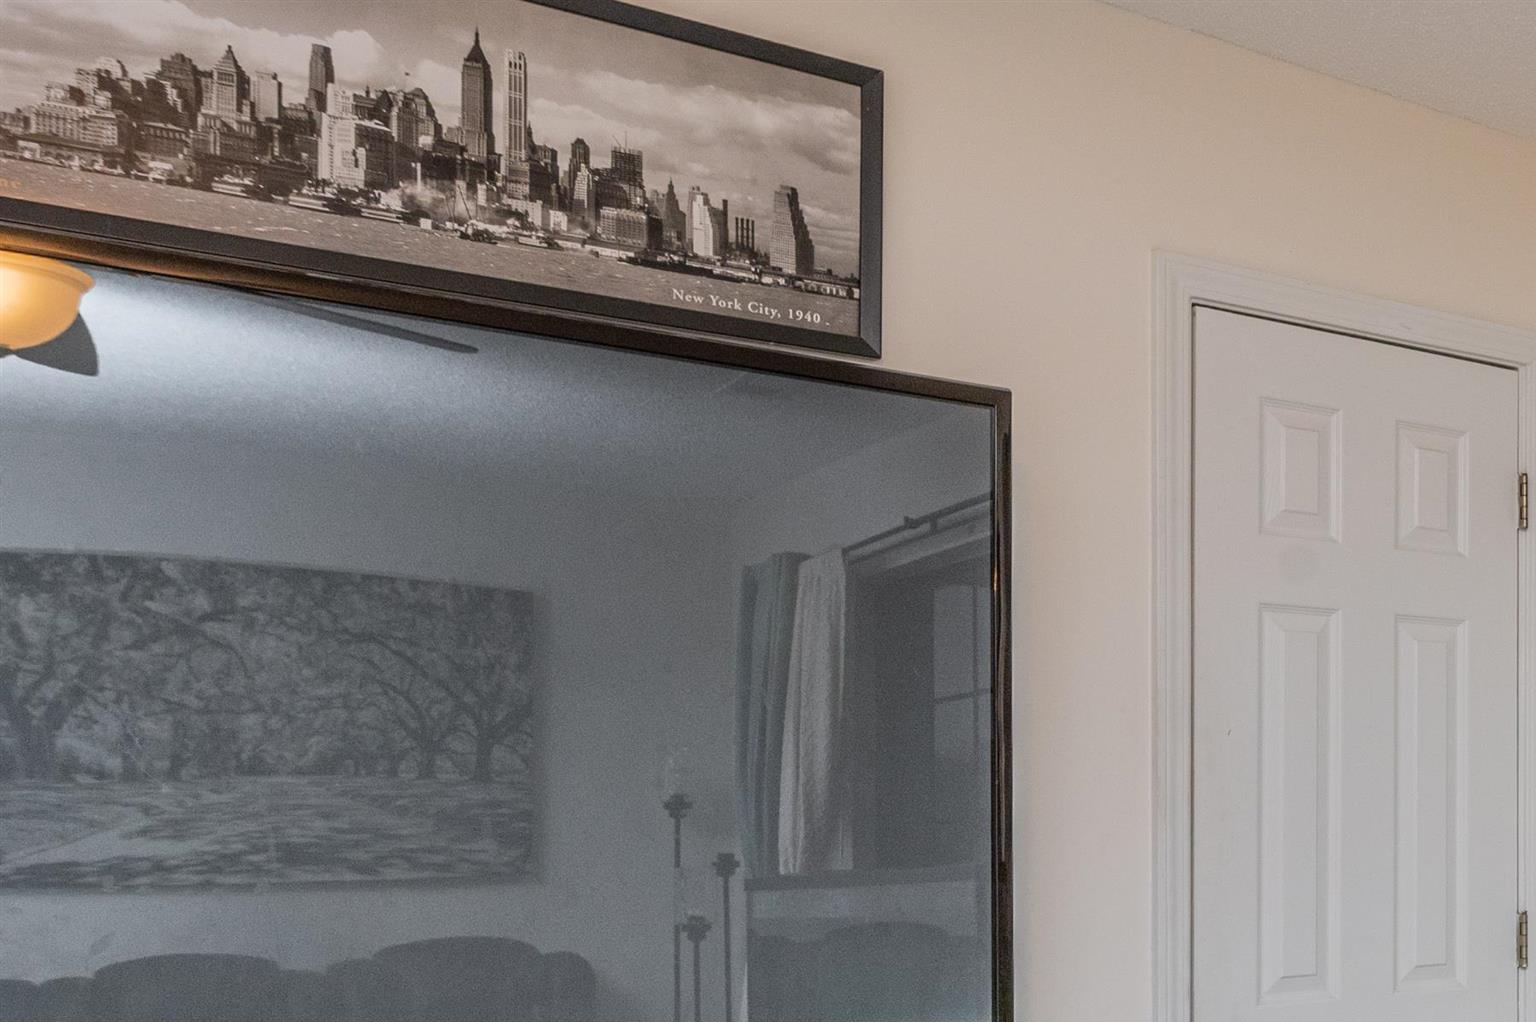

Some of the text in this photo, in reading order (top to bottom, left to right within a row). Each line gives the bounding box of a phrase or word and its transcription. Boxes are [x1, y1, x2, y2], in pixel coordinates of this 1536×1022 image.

[671, 287, 821, 324] New York City, 1940
